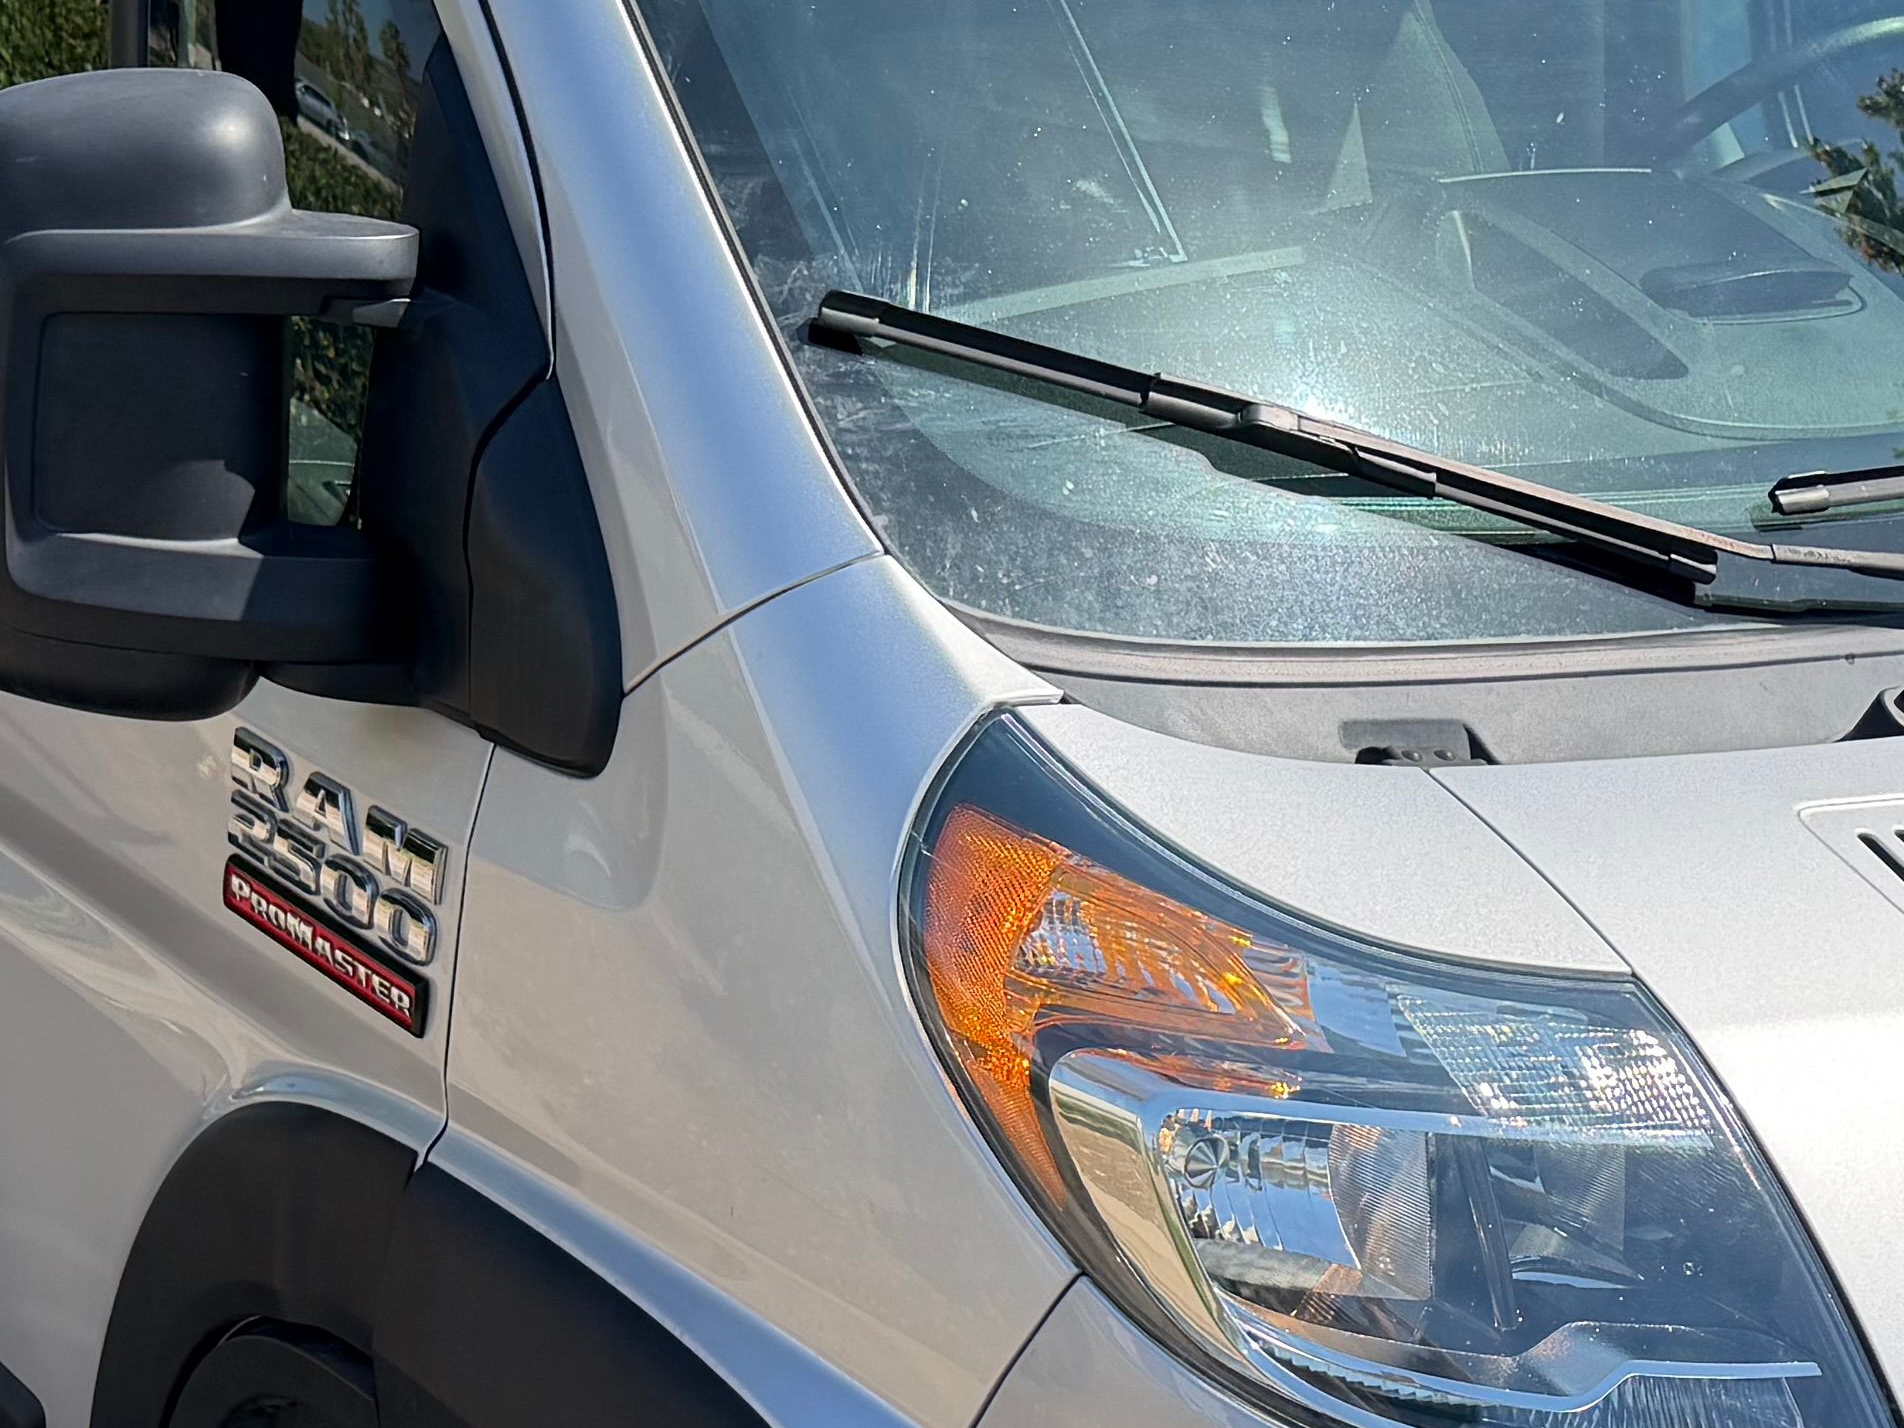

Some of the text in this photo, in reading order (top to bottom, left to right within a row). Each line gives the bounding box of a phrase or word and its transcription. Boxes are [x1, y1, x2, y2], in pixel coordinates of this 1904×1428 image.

[227, 789, 438, 967] 2500
[231, 726, 449, 906] RAM
[231, 874, 411, 1018] PROMASTER
